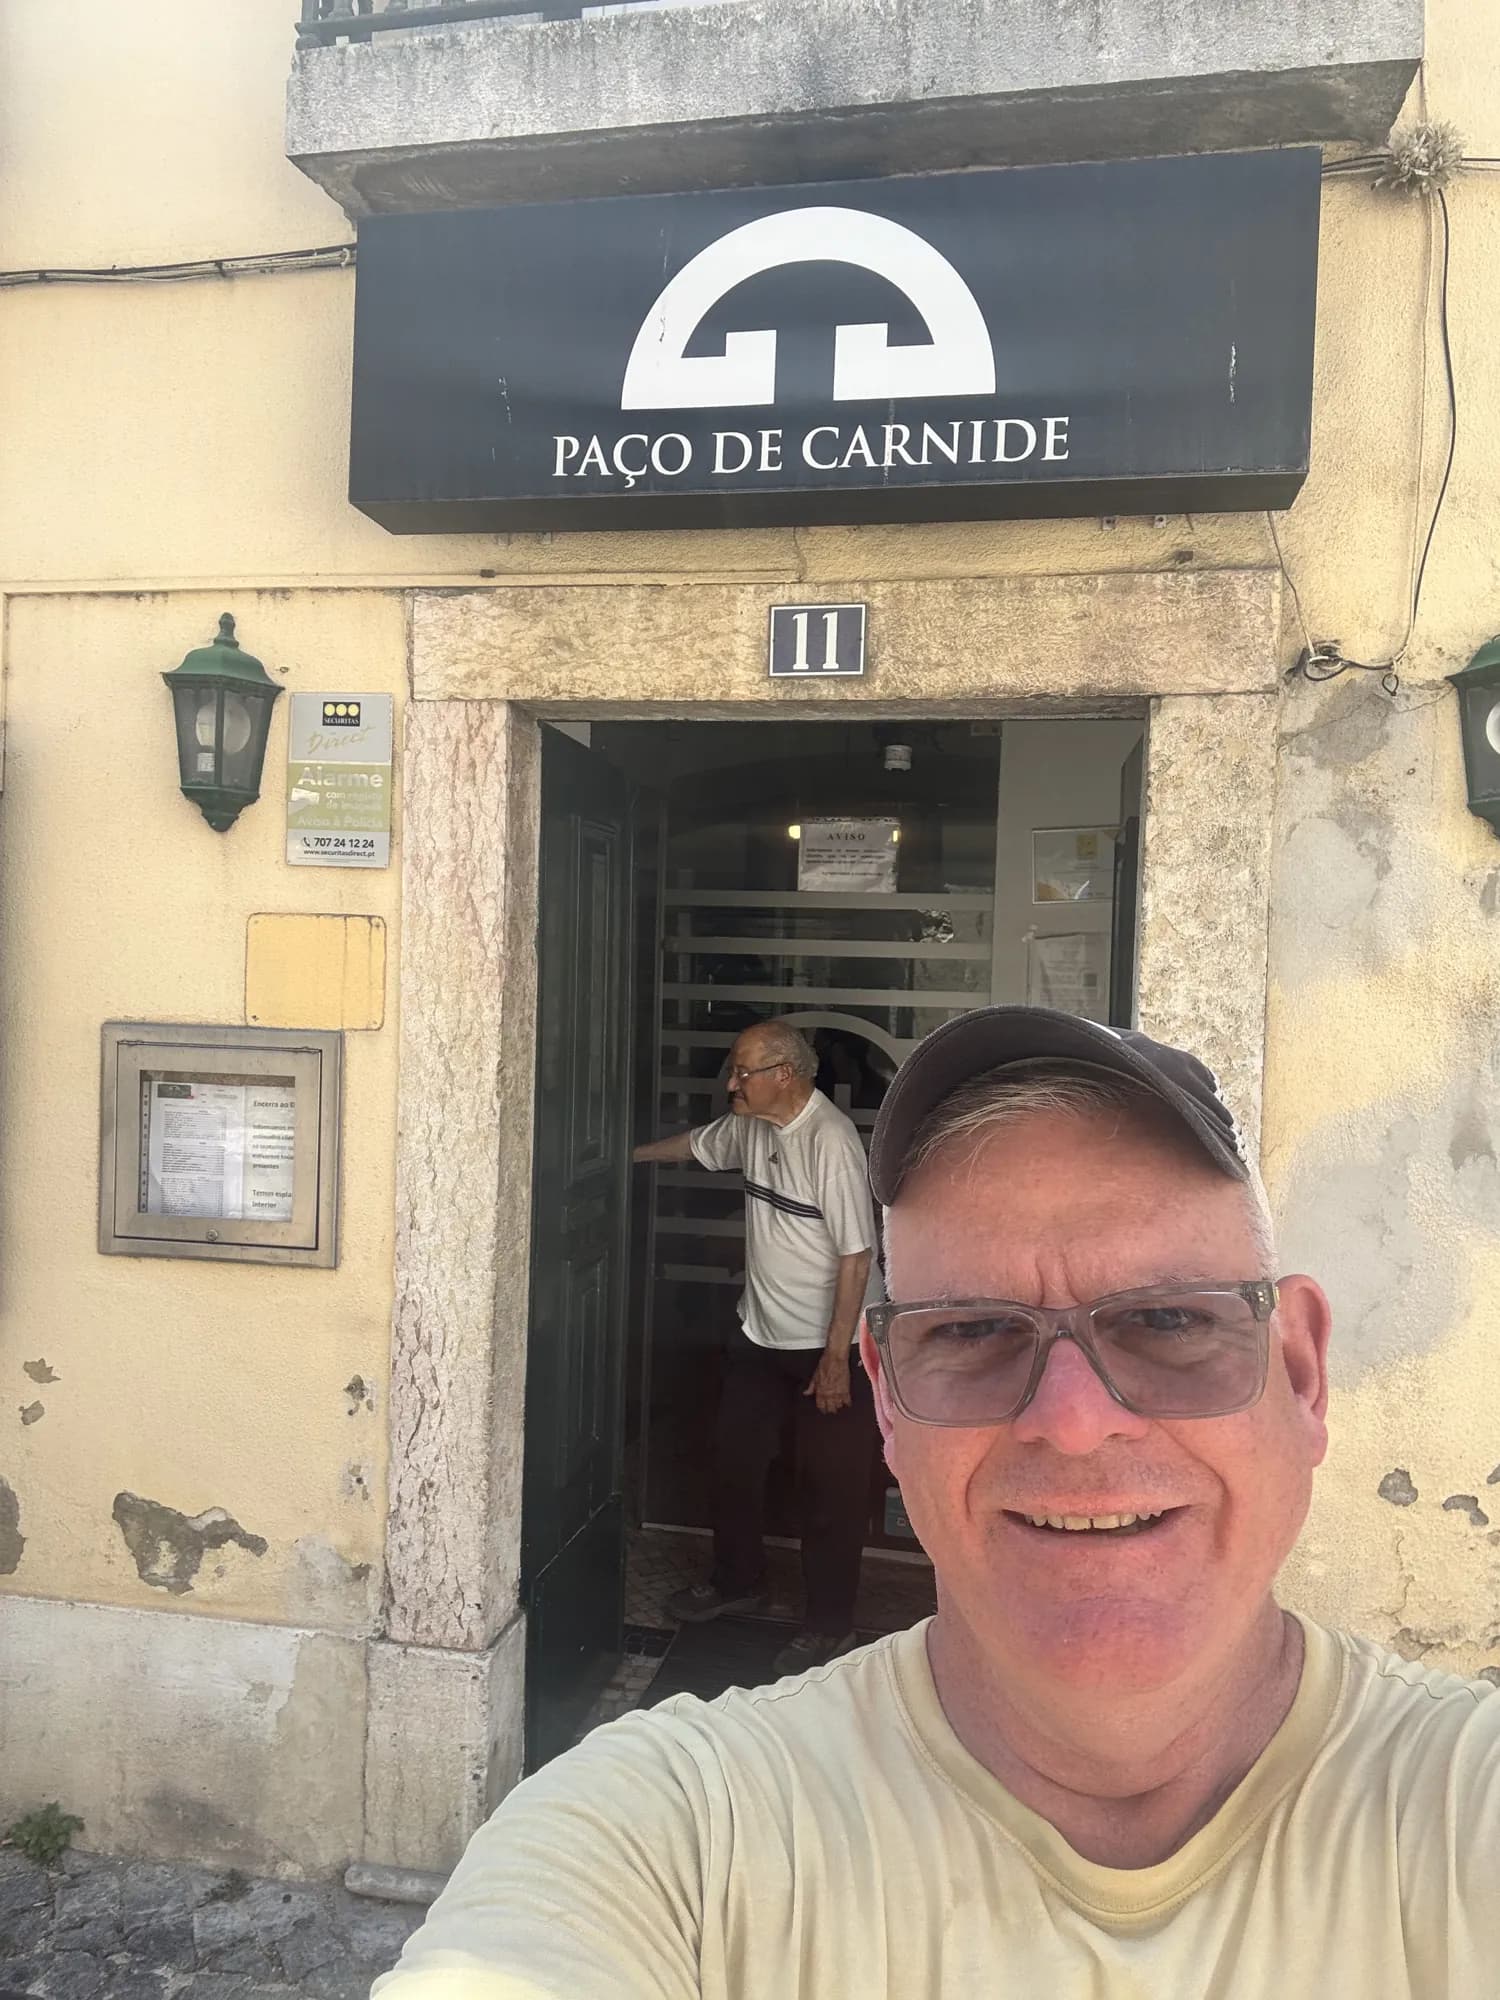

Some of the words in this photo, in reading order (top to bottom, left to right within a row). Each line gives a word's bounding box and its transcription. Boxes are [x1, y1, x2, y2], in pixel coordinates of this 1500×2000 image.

[552, 433, 693, 487] PAÇO
[710, 429, 784, 474] DE
[801, 416, 1071, 470] CARNIDE
[792, 611, 840, 670] 11
[323, 717, 359, 725] SECURITAS
[297, 766, 384, 788] Alarme
[326, 791, 346, 799] com
[827, 833, 866, 841] AVISO
[313, 837, 332, 847] 707
[334, 838, 346, 848] 24
[349, 838, 360, 848] 12
[362, 839, 375, 849] 24
[303, 850, 376, 858] www.securitasdirect.pt
